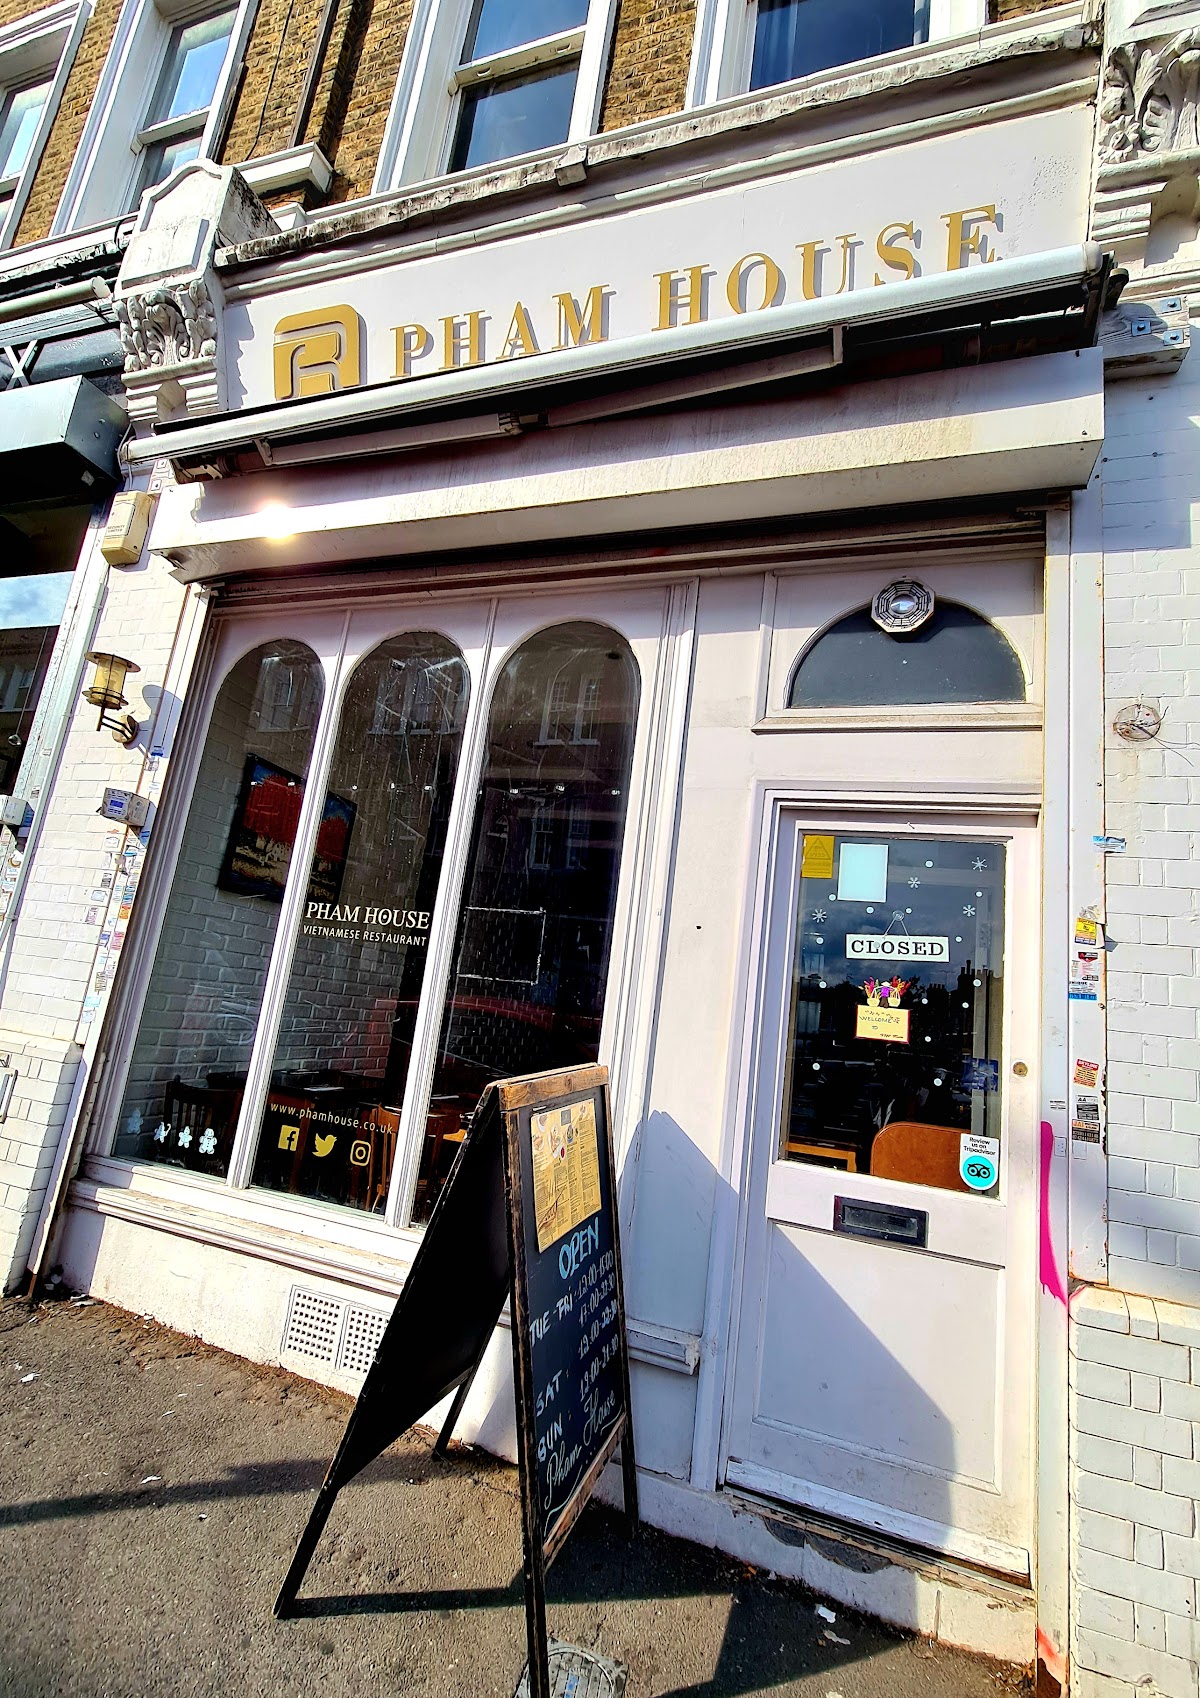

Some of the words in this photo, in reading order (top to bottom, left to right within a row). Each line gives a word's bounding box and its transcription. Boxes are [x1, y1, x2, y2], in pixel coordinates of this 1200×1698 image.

[389, 284, 614, 380] PHAM
[650, 204, 1002, 333] HOUSE
[305, 902, 361, 923] PHAM
[364, 906, 431, 930] HOUSE
[303, 925, 361, 940] VIETNAMESE
[362, 931, 427, 947] RESTAURANT
[851, 940, 944, 956] CLOSED
[270, 1103, 394, 1135] www.phamhouse.co.uk
[969, 1137, 990, 1145] Review
[558, 1216, 599, 1280] OPEN
[529, 1310, 551, 1347] TUE
[544, 1440, 583, 1511] Pham
[583, 1388, 616, 1447] House
